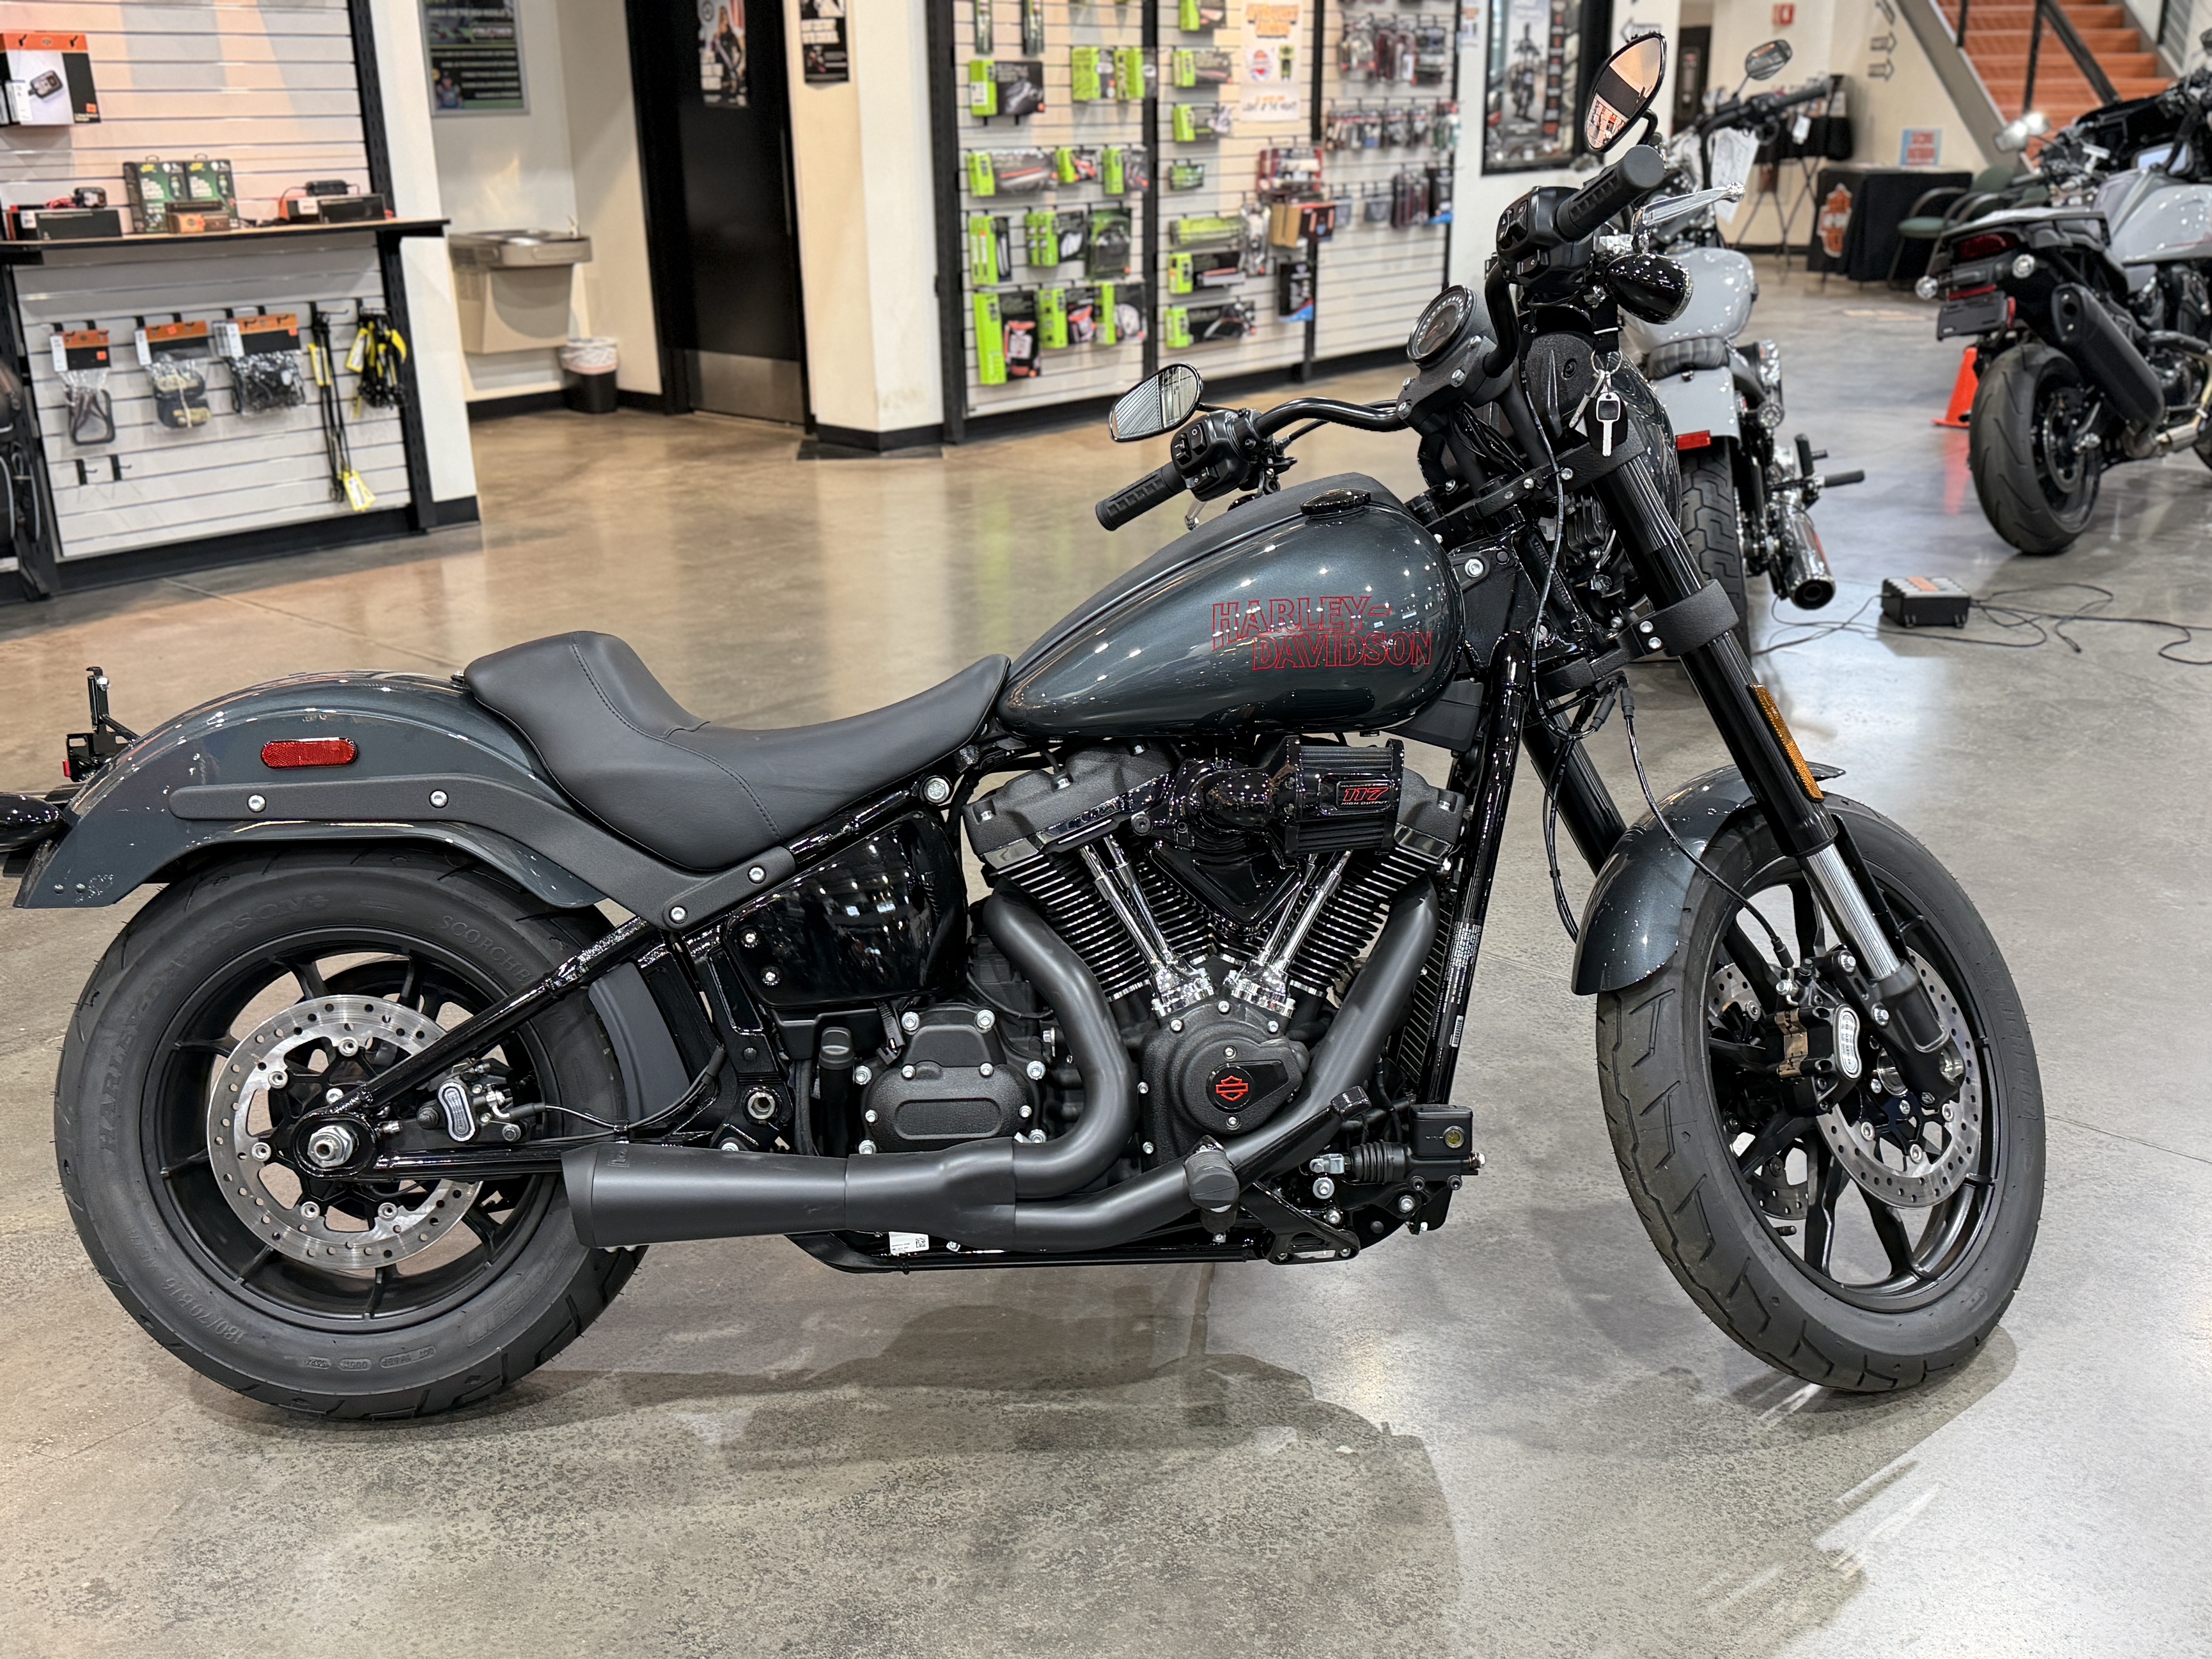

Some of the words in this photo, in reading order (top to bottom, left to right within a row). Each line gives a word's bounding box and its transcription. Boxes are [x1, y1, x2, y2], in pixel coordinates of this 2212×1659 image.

[1212, 595, 1394, 652] HARLEY-
[1253, 631, 1432, 671] DAVIDSON
[1343, 787, 1389, 802] 117
